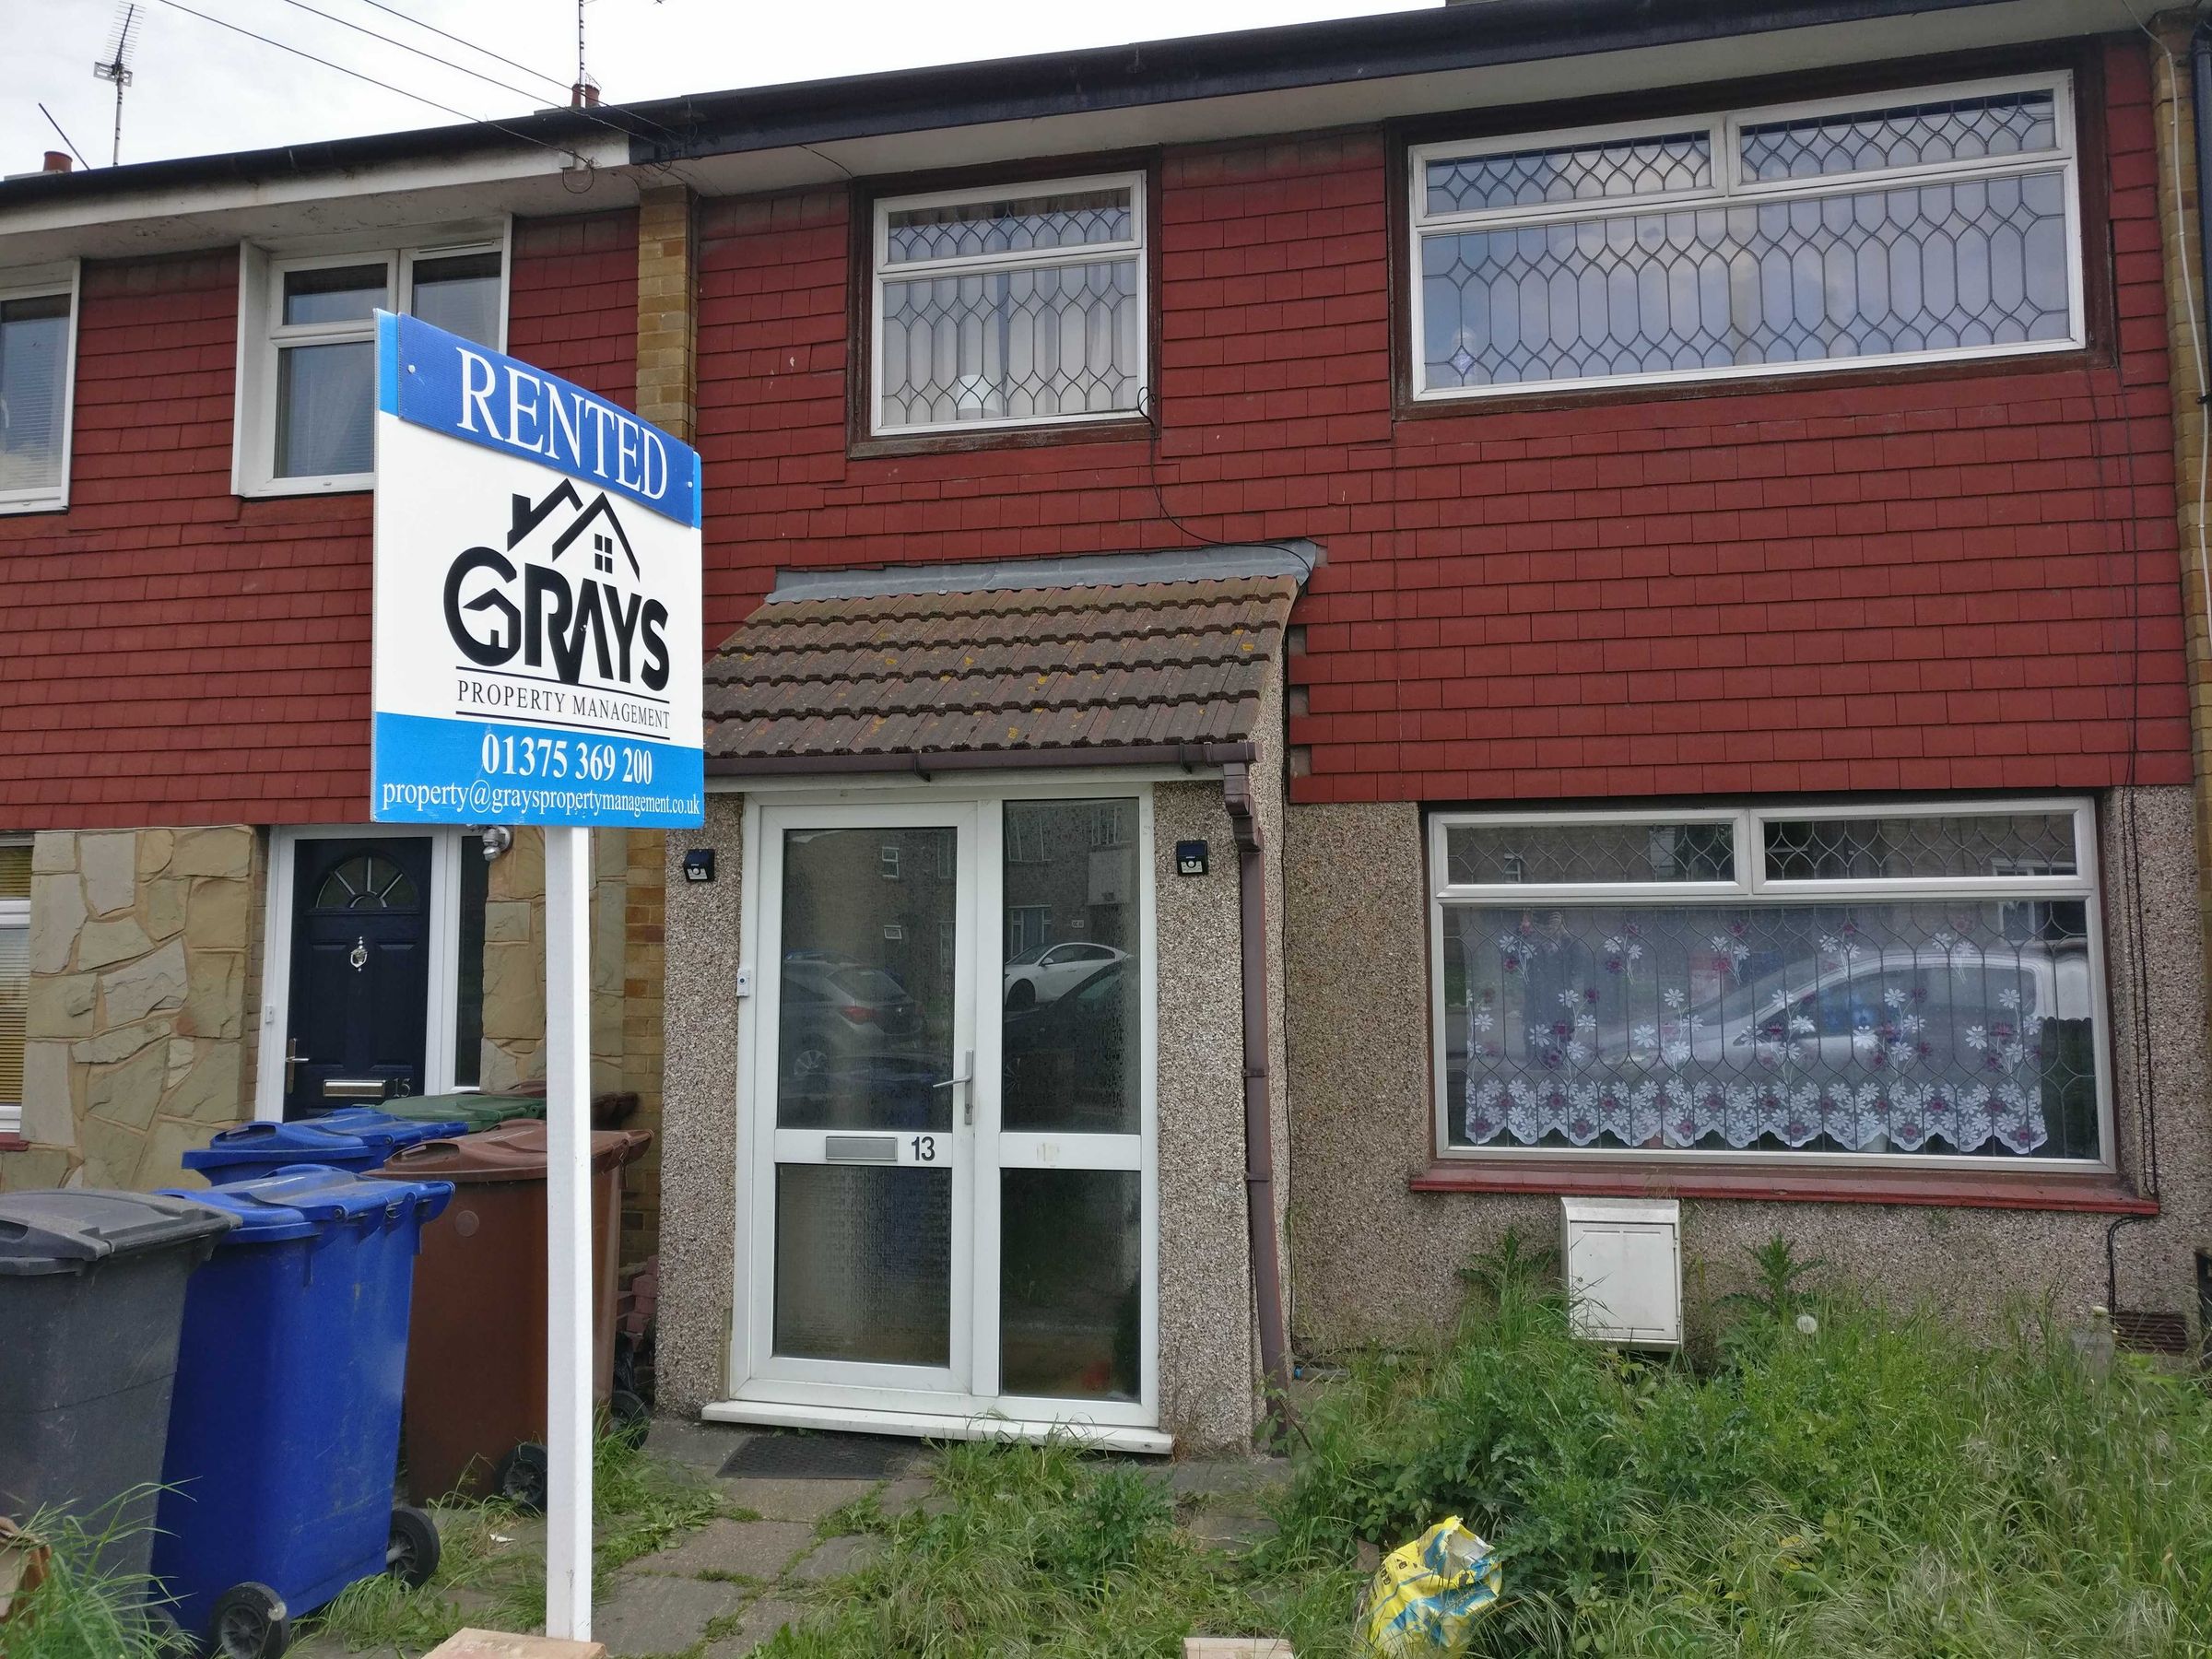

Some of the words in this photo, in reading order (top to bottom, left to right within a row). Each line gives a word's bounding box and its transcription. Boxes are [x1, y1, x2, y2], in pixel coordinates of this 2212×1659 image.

[455, 347, 668, 500] RENTED
[443, 546, 670, 691] GRAYS
[457, 679, 566, 712] PROPERTY
[572, 694, 671, 730] MANAGEMENT
[481, 734, 568, 779] 01375
[575, 744, 616, 782] 369
[622, 747, 653, 785] 200
[382, 779, 700, 818] property@grayspropertymanagement.co.uk
[393, 1077, 411, 1098] 15
[911, 1135, 935, 1161] 13
